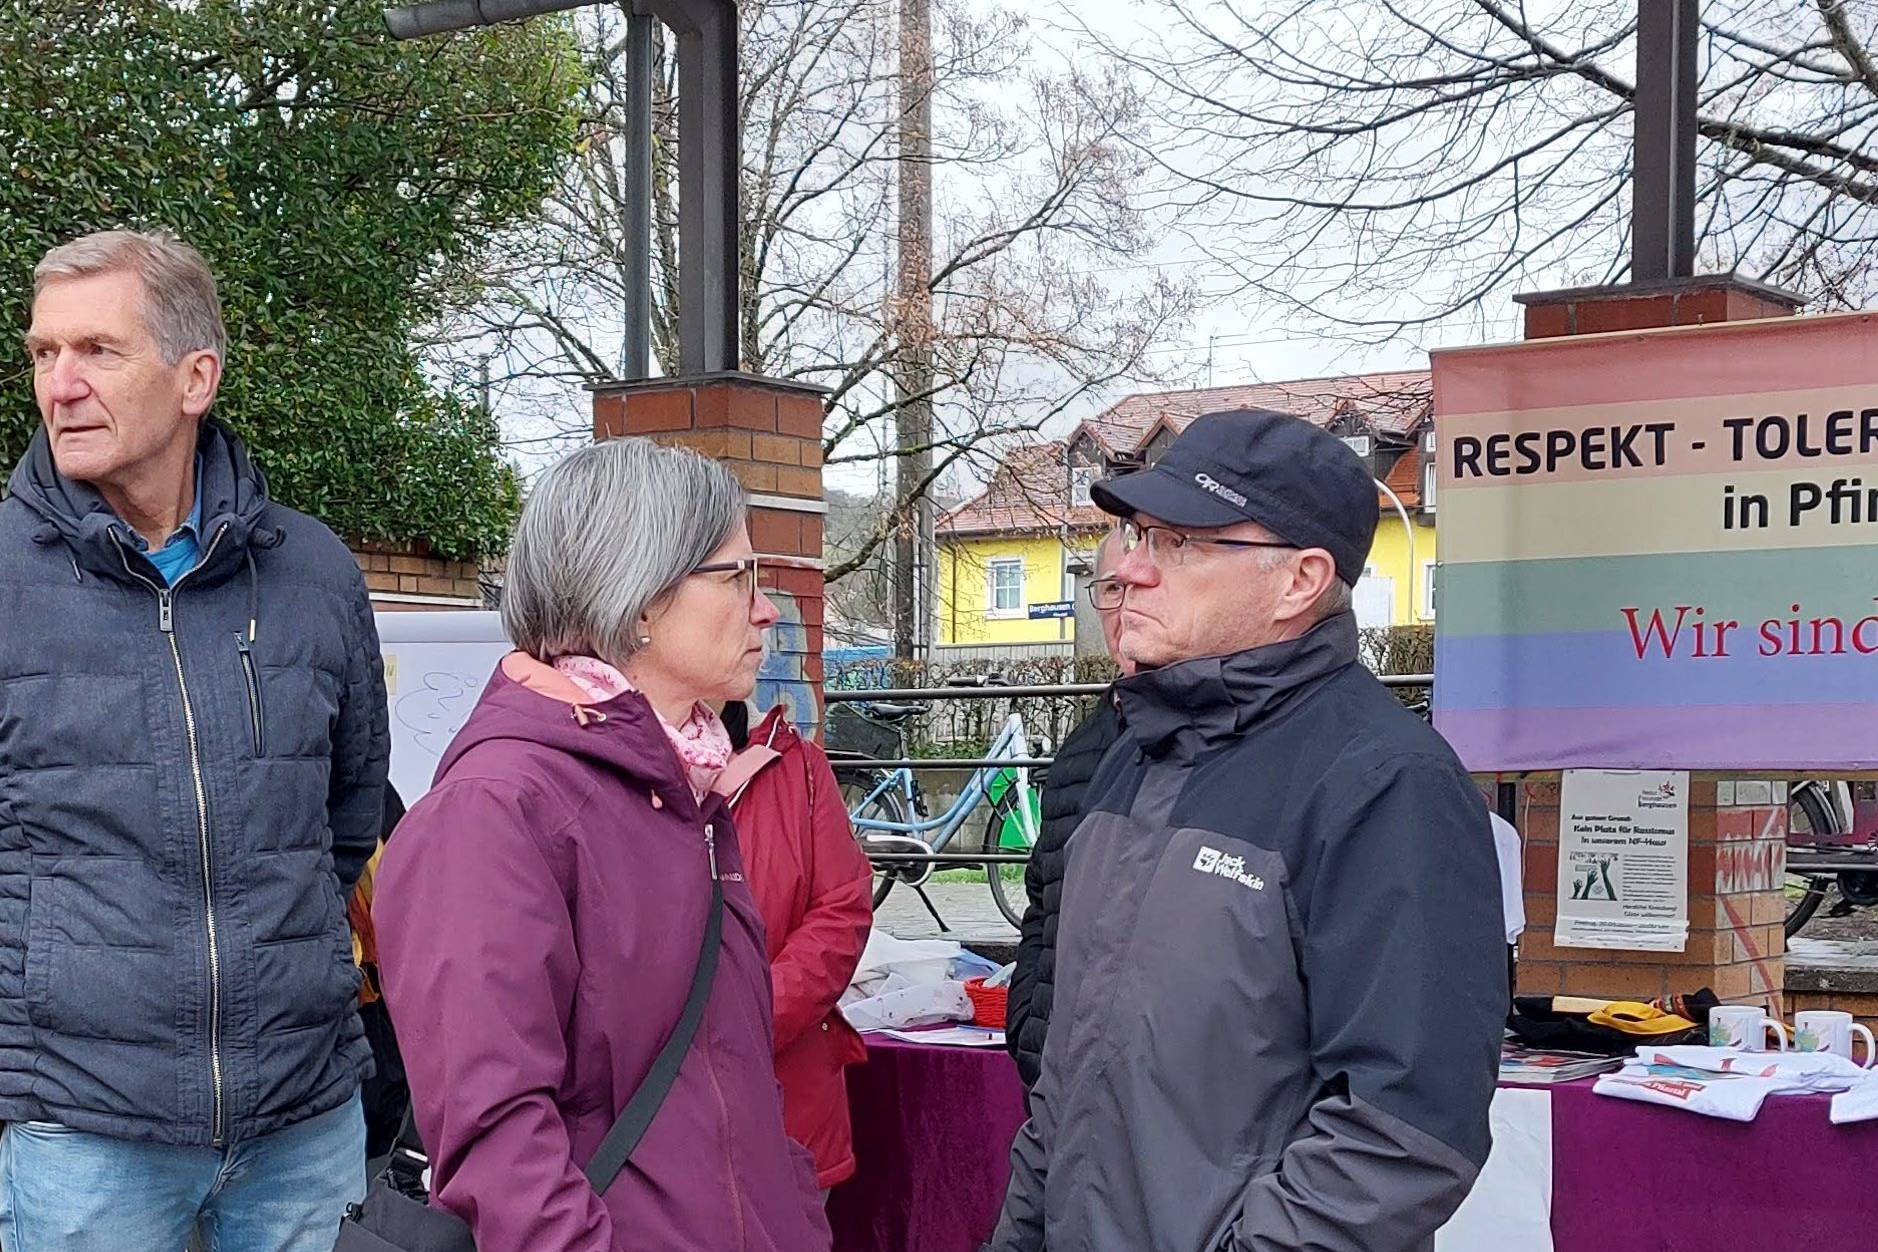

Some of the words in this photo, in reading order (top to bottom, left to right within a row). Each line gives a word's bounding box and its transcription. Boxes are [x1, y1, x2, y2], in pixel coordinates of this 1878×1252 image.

[1453, 422, 1675, 479] RESPEKT
[1723, 408, 1878, 462] TOLER
[1723, 485, 1769, 530] in
[1620, 605, 1738, 659] Wir
[1758, 596, 1878, 657] sind
